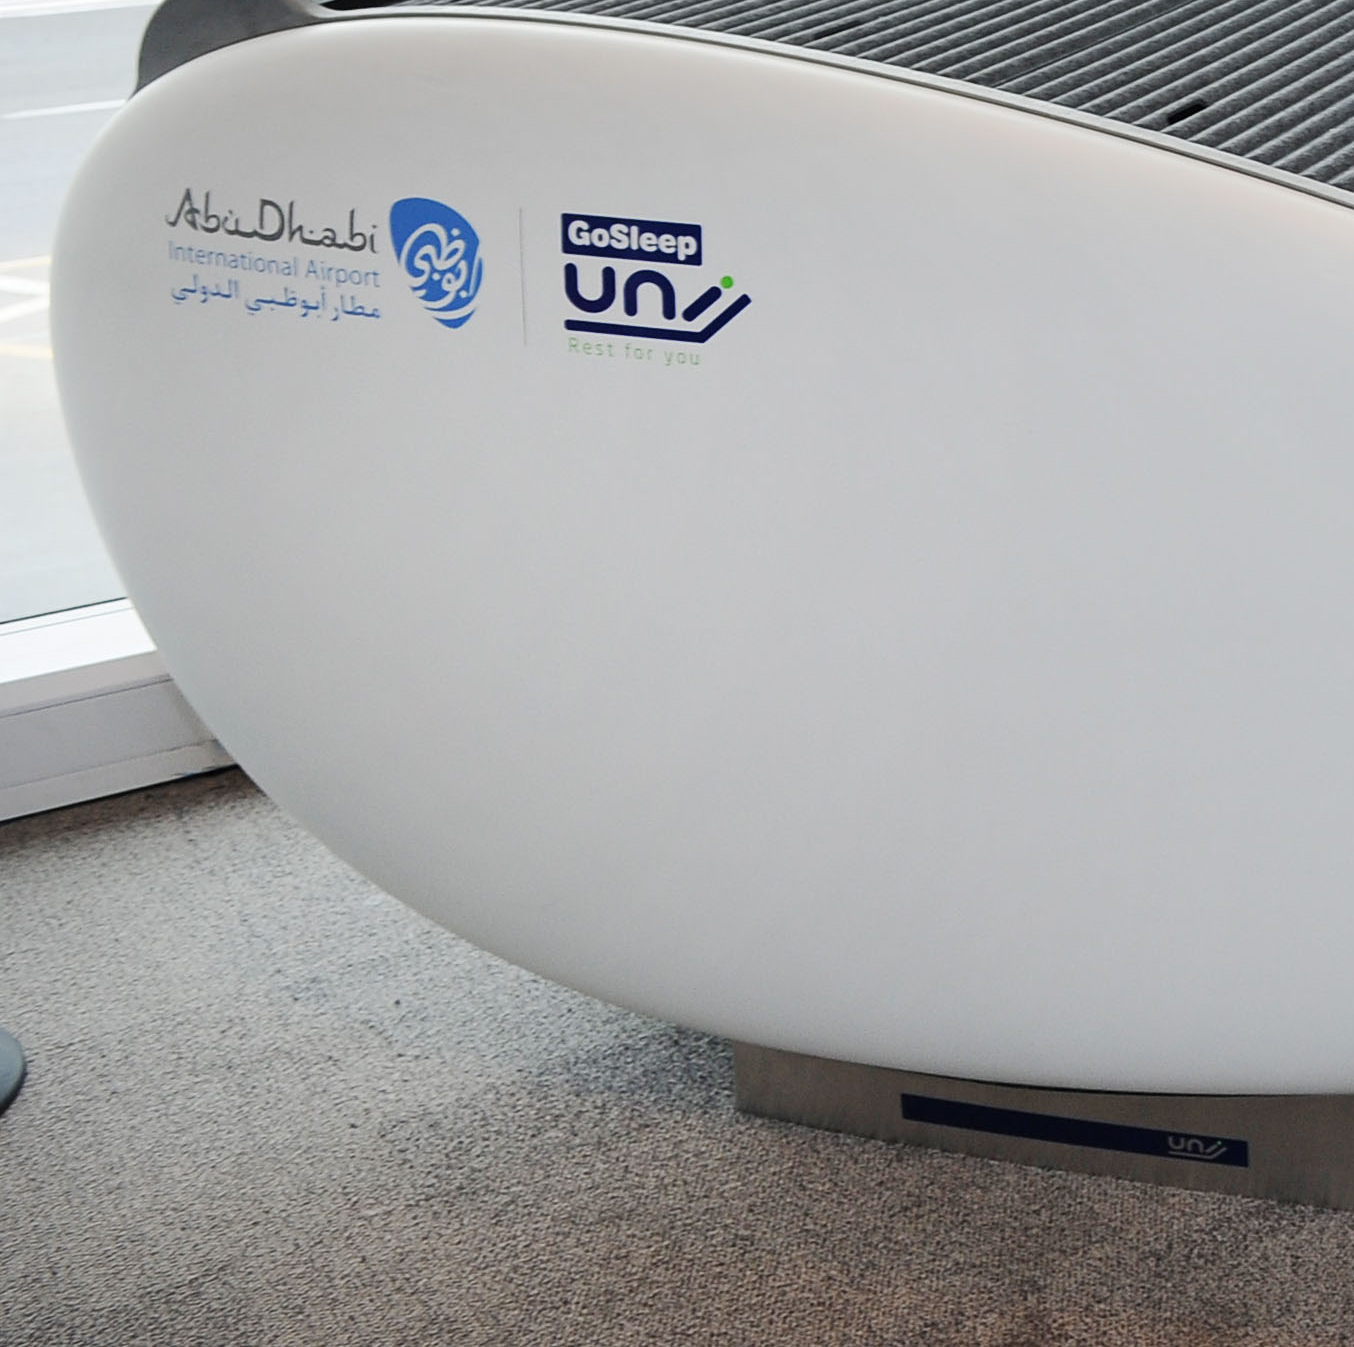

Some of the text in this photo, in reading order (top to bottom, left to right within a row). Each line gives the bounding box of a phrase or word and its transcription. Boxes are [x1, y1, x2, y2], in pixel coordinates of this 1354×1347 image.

[568, 220, 698, 261] GoSleep
[168, 240, 381, 289] International Airport
[567, 336, 701, 367] Rest for you
